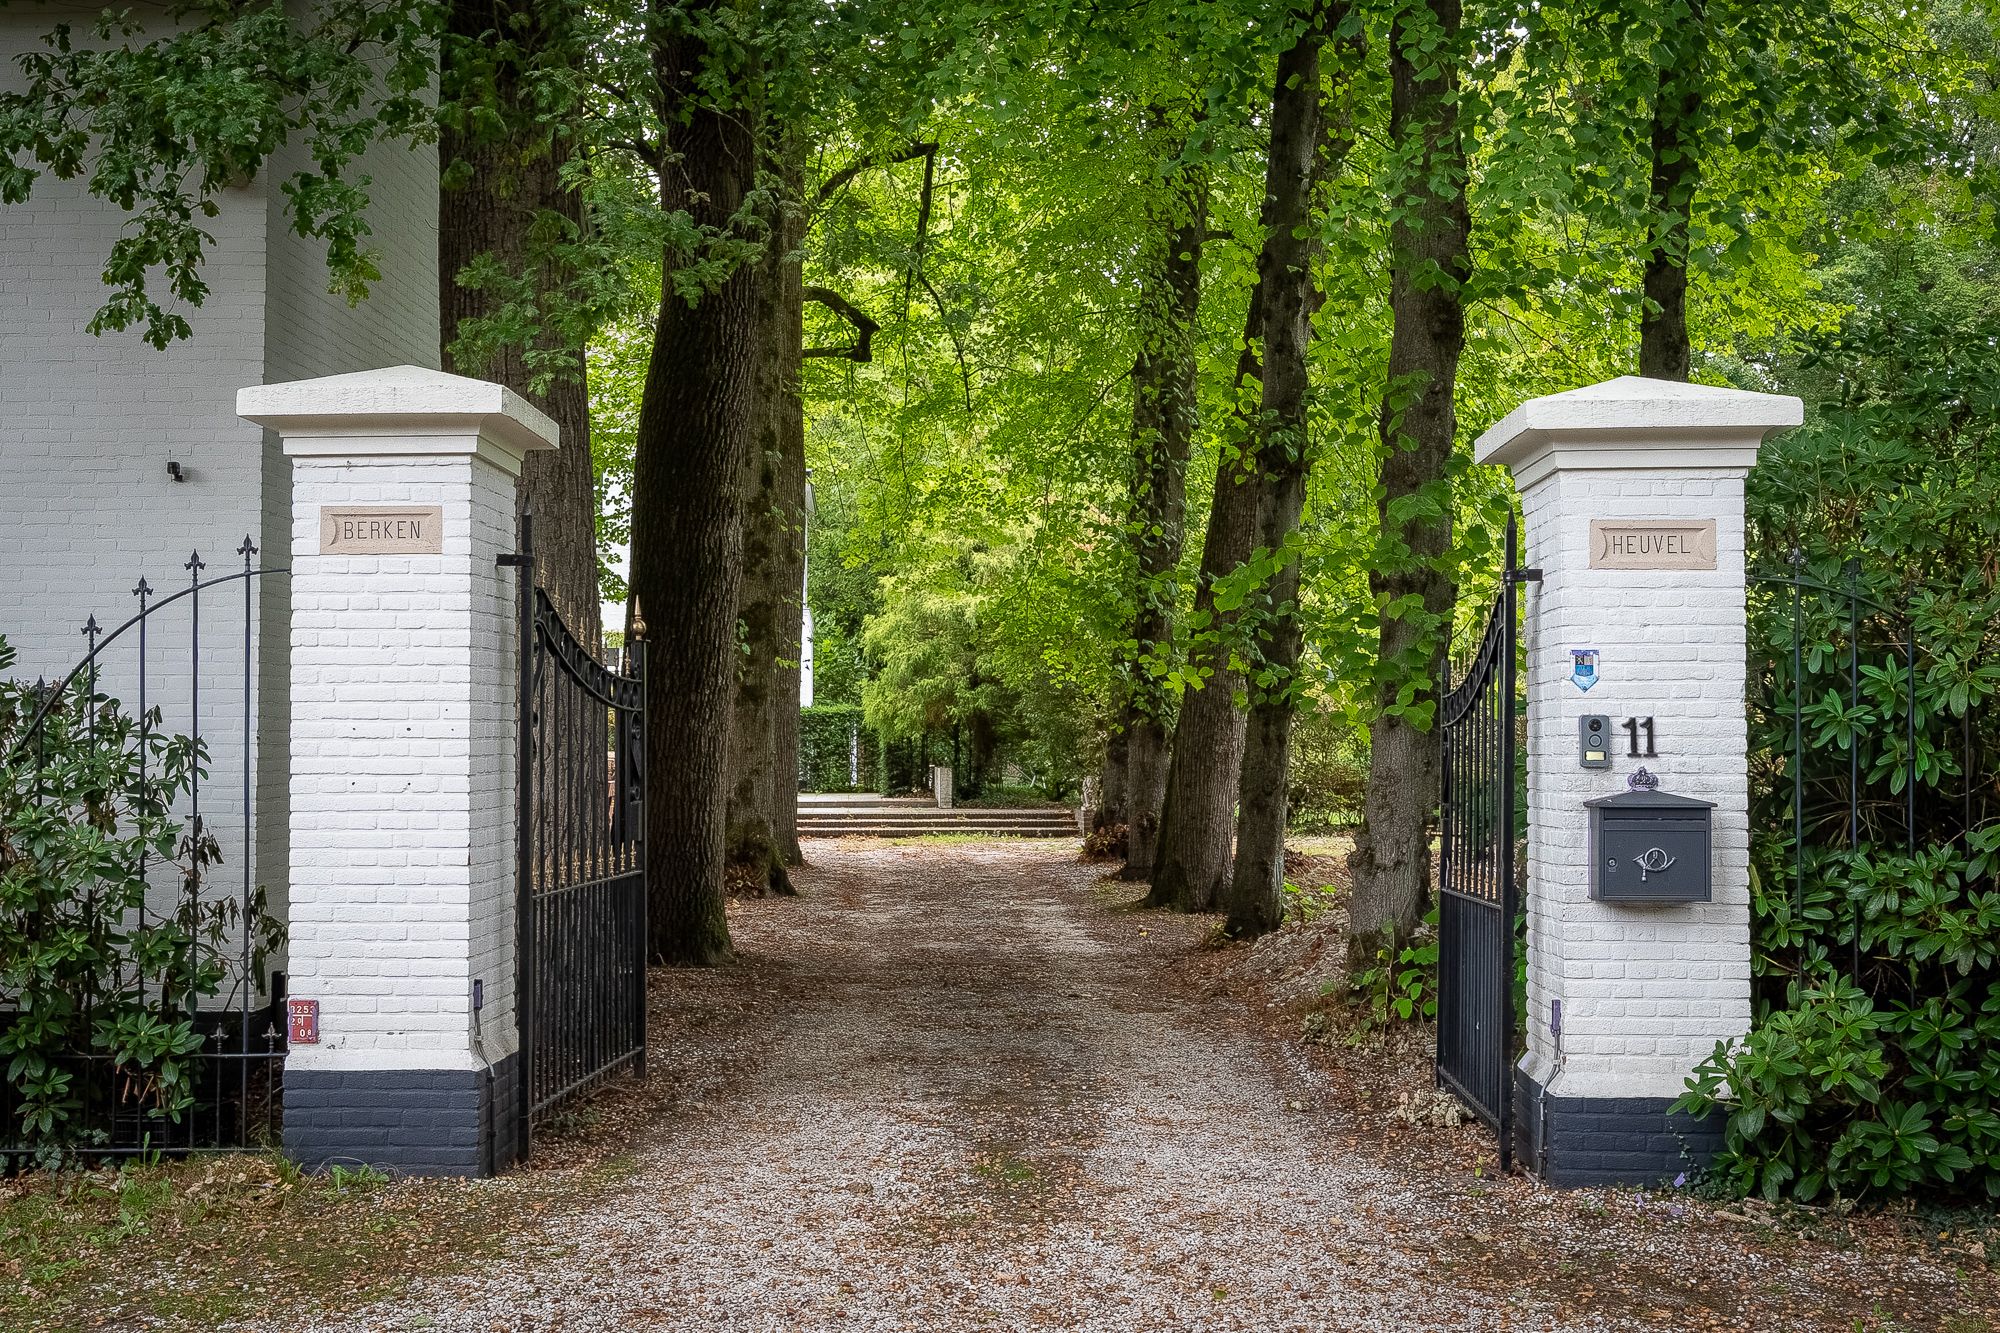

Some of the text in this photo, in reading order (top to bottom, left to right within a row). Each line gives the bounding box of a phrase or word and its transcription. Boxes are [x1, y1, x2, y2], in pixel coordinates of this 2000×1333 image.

[344, 520, 421, 540] BERKEN
[1612, 535, 1691, 555] HEUVEL
[1621, 716, 1659, 758] 11
